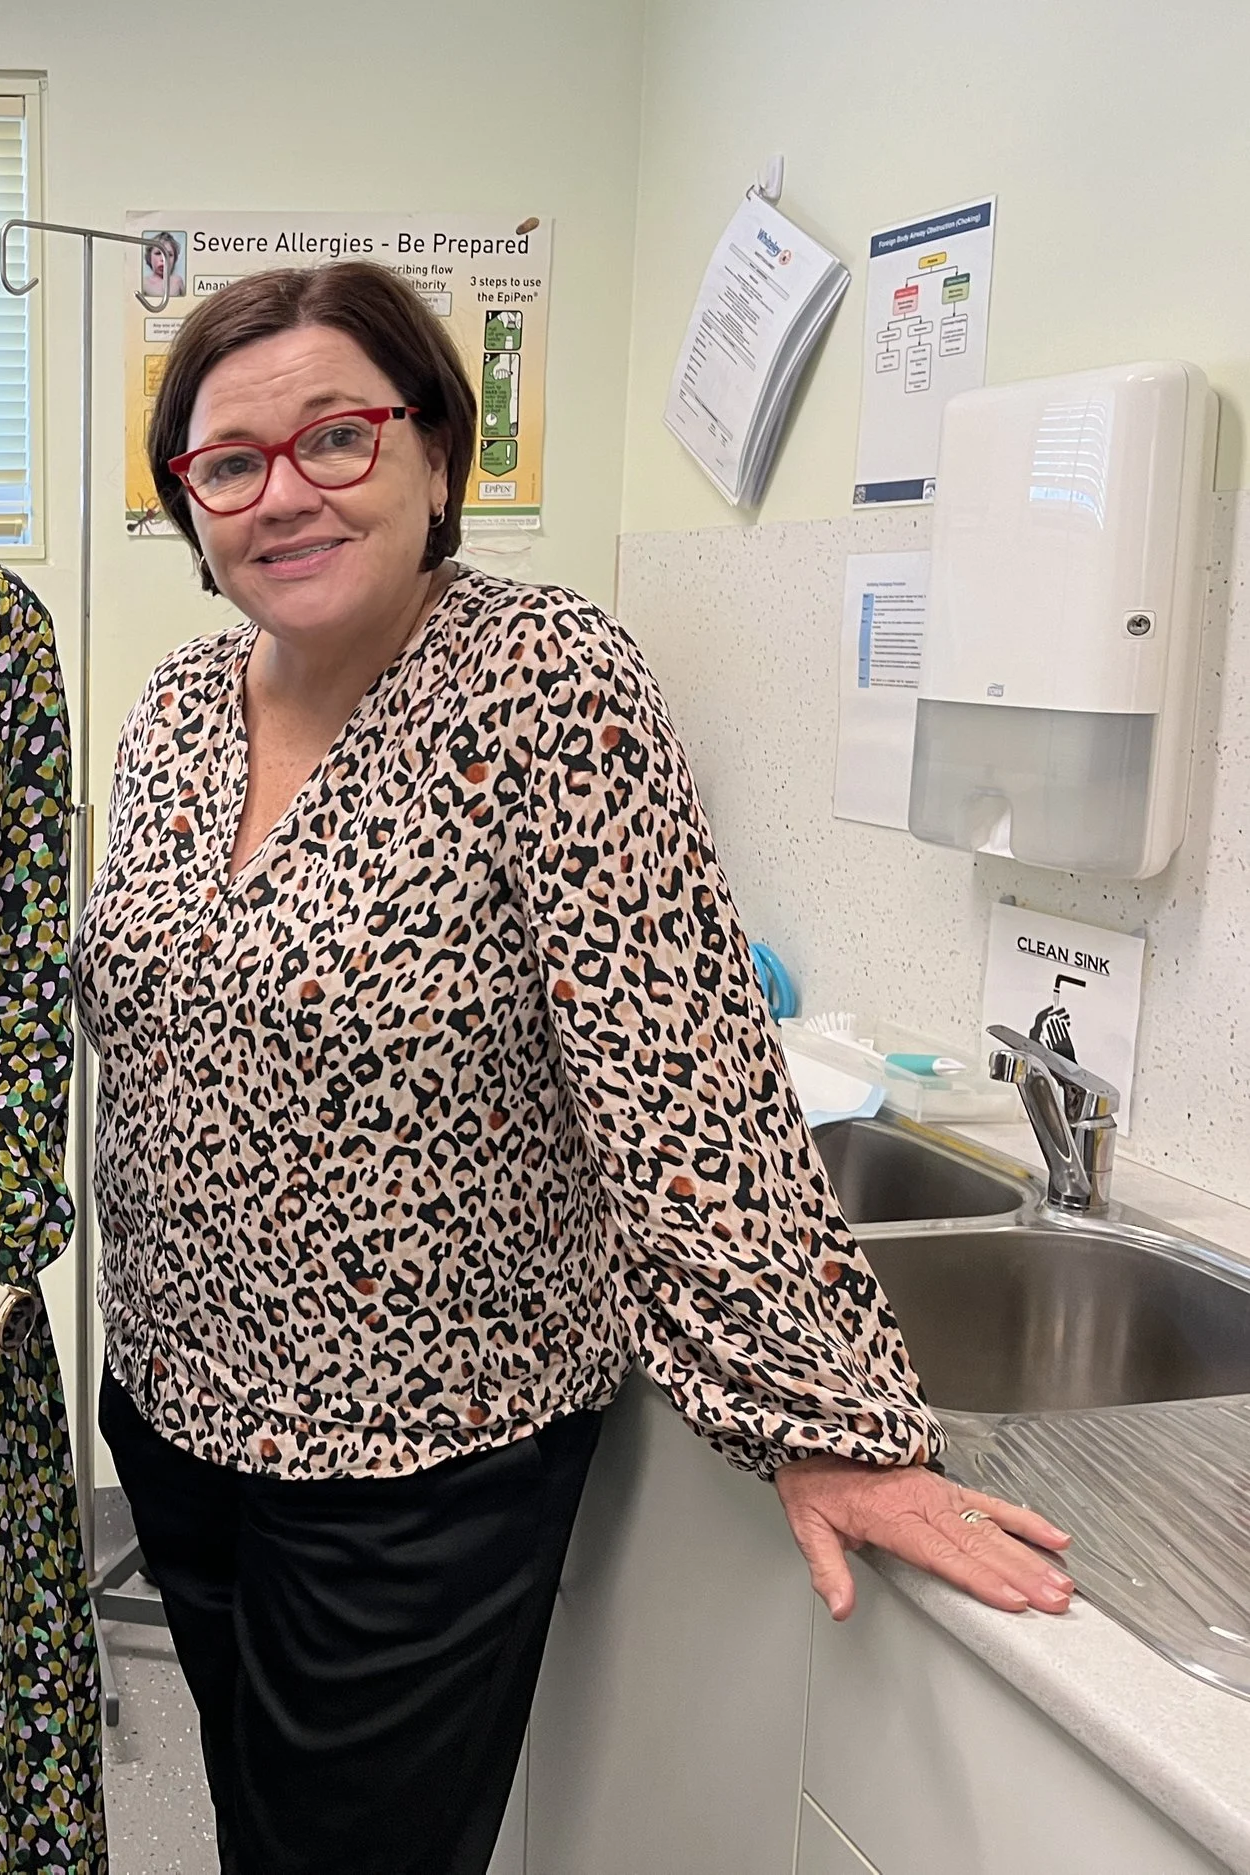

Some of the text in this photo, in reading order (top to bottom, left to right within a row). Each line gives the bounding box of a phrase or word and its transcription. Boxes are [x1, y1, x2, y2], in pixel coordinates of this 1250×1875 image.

[193, 232, 268, 252] Severe
[275, 232, 374, 258] Allergies
[398, 233, 425, 253] Be
[433, 233, 529, 258] Prepared
[392, 264, 454, 276] cribing flow
[197, 280, 229, 291] Anap
[410, 280, 447, 291] thority
[470, 276, 542, 289] 3 steps to use
[477, 292, 494, 302] the
[488, 311, 492, 320] 1
[485, 353, 491, 362] 2
[482, 440, 488, 449] 3
[1017, 936, 1111, 974] CLEAN SINK
